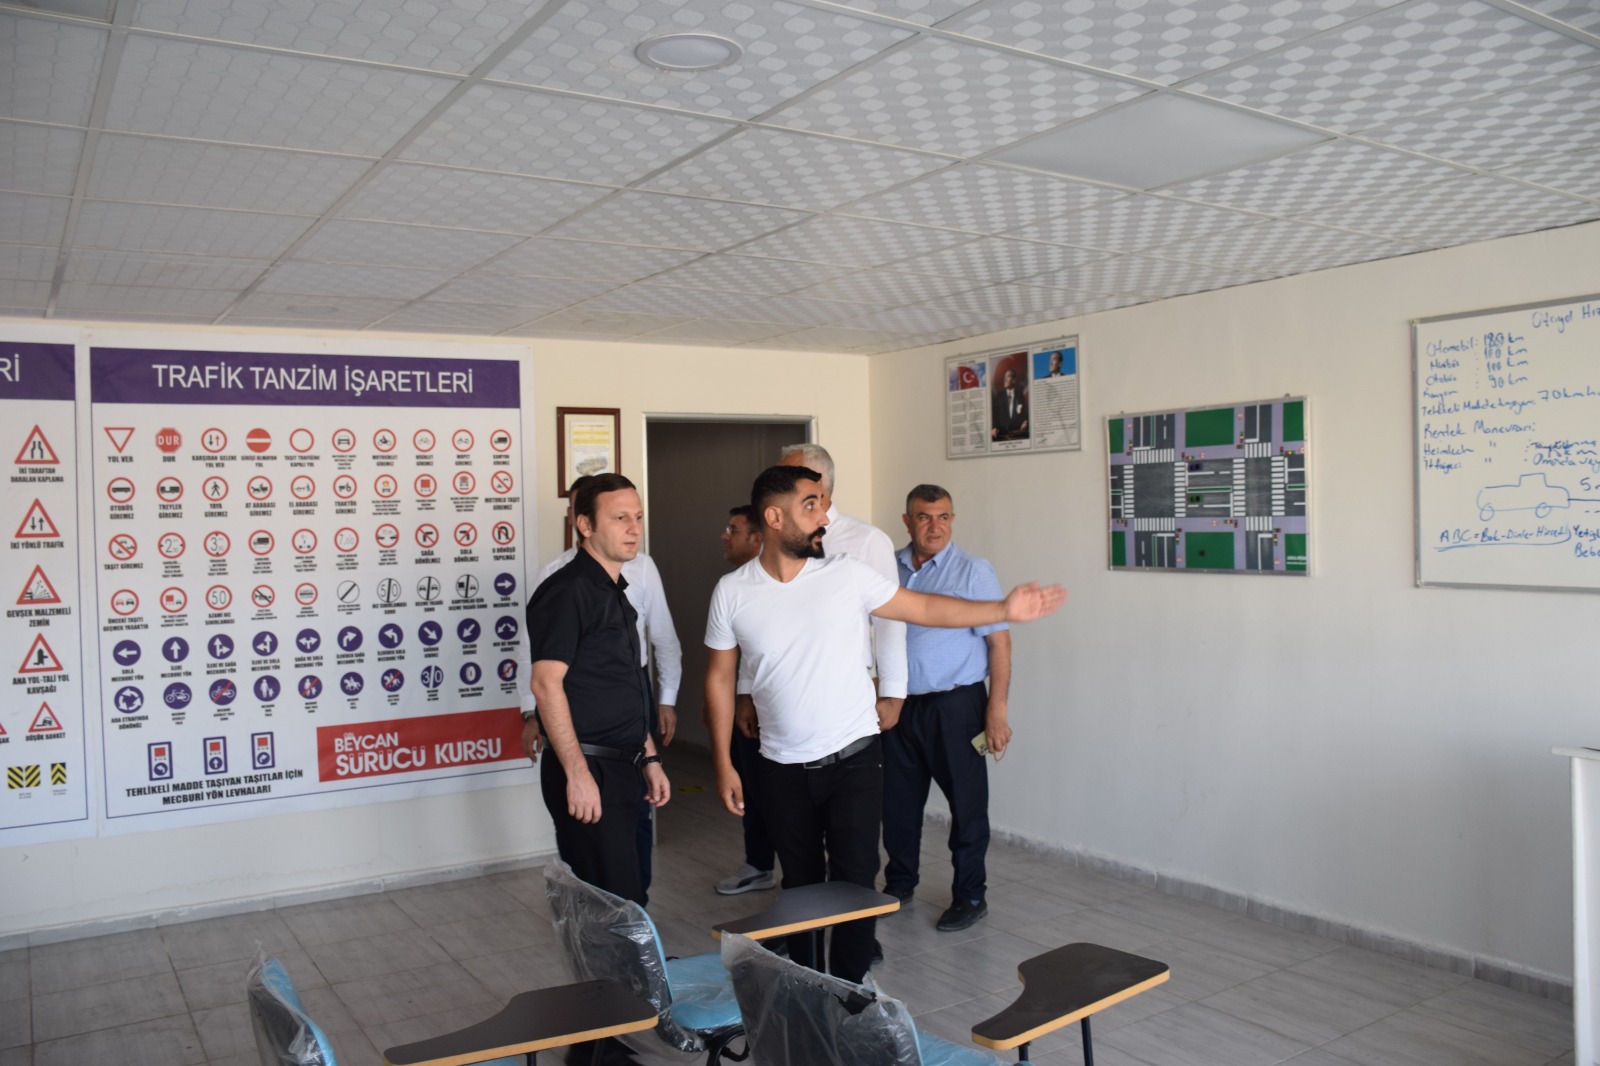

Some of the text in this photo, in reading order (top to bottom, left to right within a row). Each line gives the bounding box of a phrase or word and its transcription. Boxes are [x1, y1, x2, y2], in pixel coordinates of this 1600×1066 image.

[152, 362, 473, 396] TRAFİK TANZİM İŞARETLERİ
[158, 435, 180, 446] DUR
[42, 540, 64, 548] TRAFİK
[12, 677, 26, 686] ANA
[334, 732, 399, 753] BEYCAN
[336, 737, 501, 776] SÜRÜCÜ KURSU
[126, 769, 304, 798] TEHLİKELİ MADDE TAŞIYAN TAŞITLAR İÇİN
[162, 784, 271, 806] MECBURİ YÖN LEVHALARI
